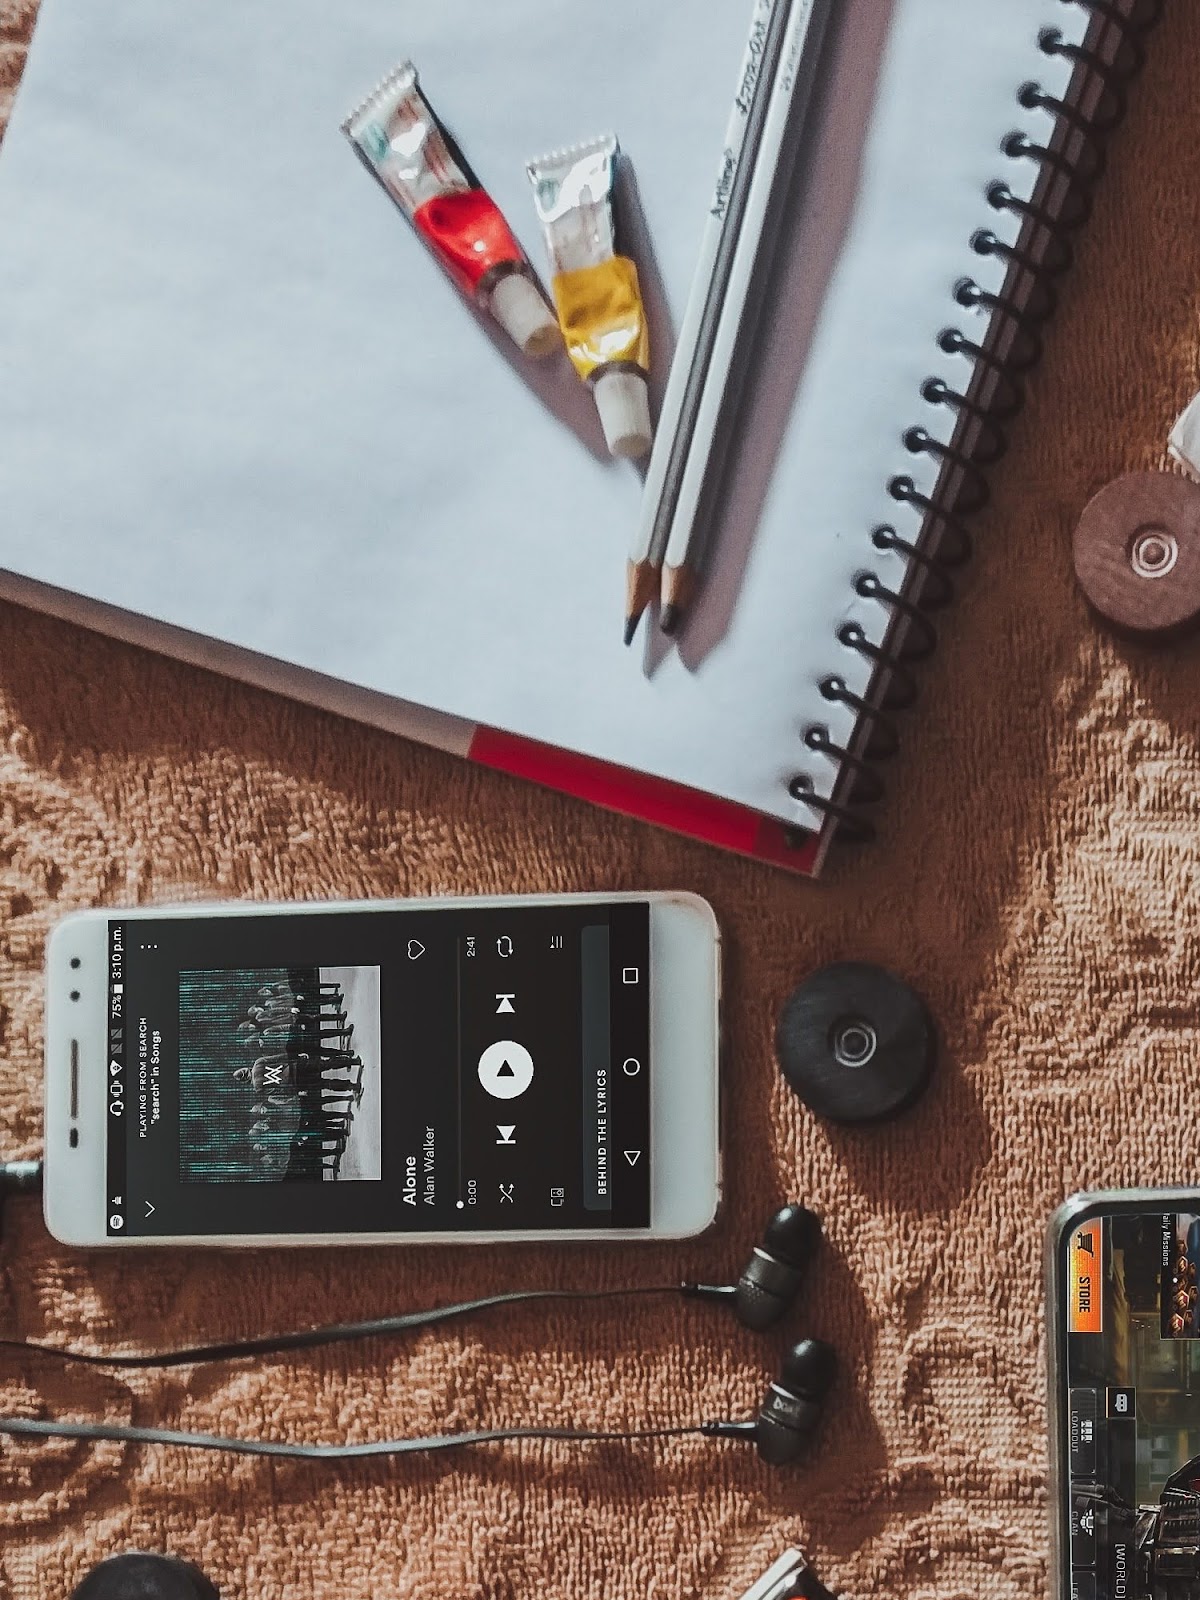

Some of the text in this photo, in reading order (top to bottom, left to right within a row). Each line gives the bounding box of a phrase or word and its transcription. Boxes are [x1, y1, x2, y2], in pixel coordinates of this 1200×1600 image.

[112, 926, 124, 979] 3:10 p.m.
[466, 936, 476, 957] 2:41
[112, 995, 122, 1019] 75%
[139, 1017, 147, 1138] PLAYING FROM SEARCH
[150, 1030, 161, 1125] "search" in Songs
[596, 1069, 607, 1195] BEHIND THE LYRICS
[402, 1156, 417, 1206] Alone
[423, 1126, 435, 1206] Alan Walker
[468, 1180, 477, 1205] 0:00
[1163, 1231, 1171, 1266] Missions
[1079, 1276, 1091, 1313] STORE
[1071, 1410, 1079, 1453] LOADOUT
[1071, 1511, 1079, 1536] CLAN
[1115, 1543, 1126, 1599] [WORLD]
